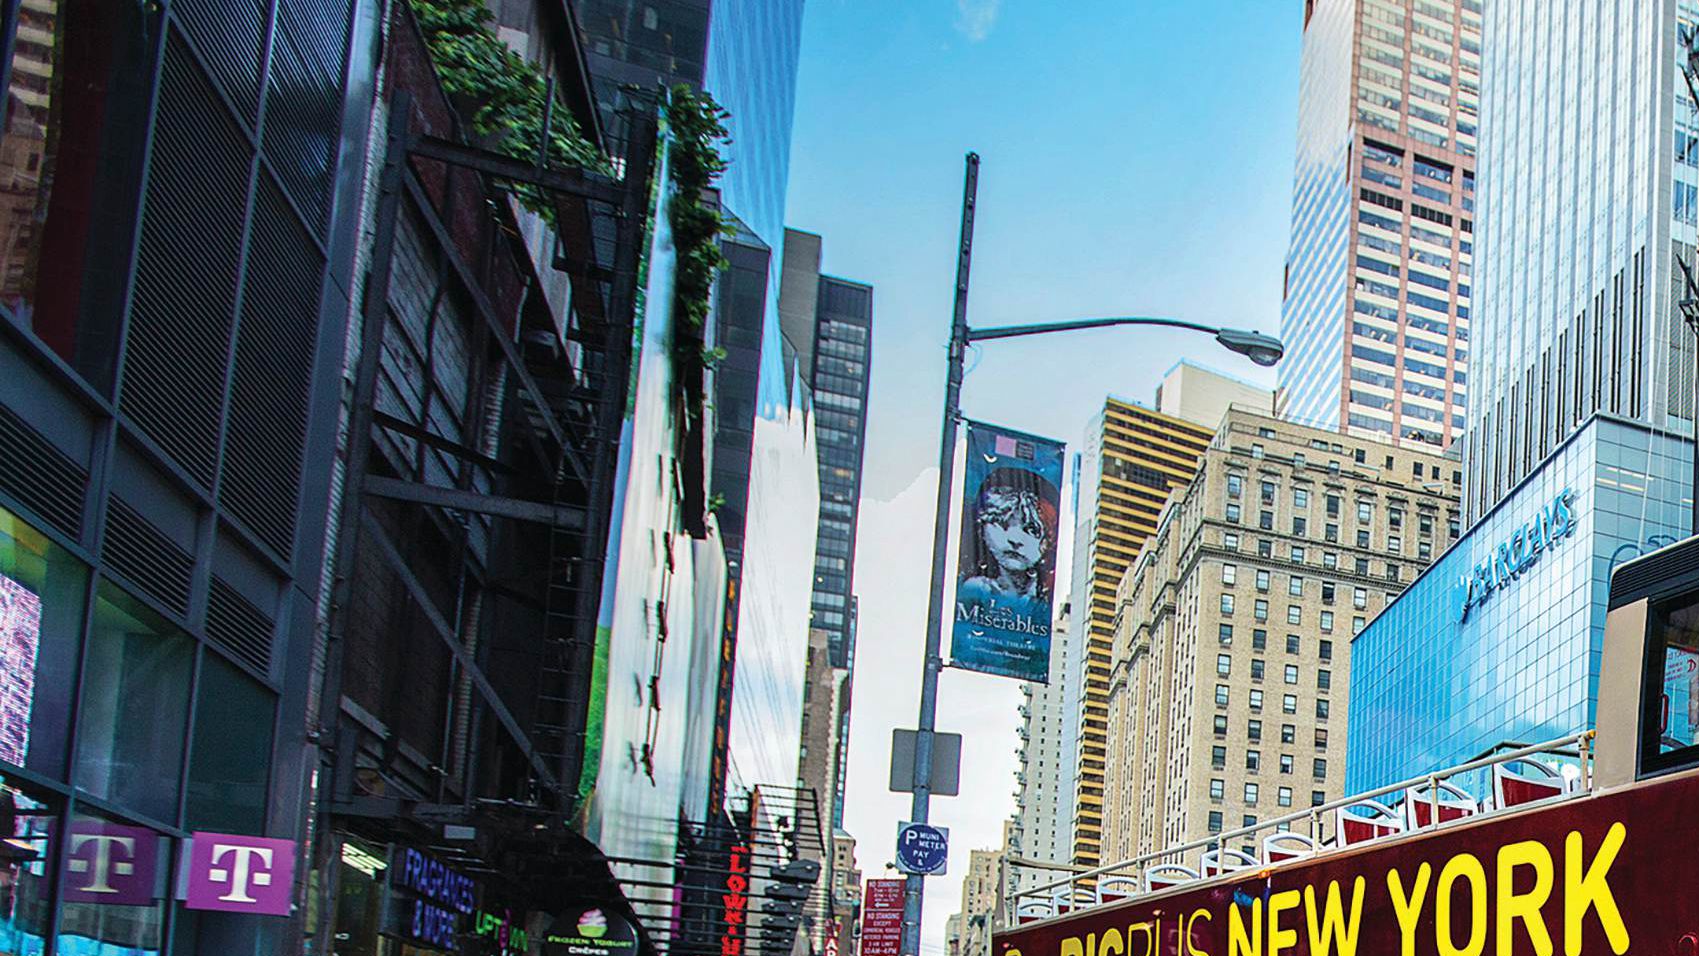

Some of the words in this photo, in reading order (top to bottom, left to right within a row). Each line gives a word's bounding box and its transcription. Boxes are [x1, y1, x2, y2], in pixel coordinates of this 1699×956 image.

[1471, 488, 1572, 602] BARCLAYS
[905, 830, 918, 845] P
[919, 832, 940, 840] MUNI
[919, 840, 946, 850] METER
[912, 849, 929, 858] PAY
[68, 835, 135, 893] T
[208, 844, 273, 903] T
[548, 935, 590, 945] FROZEN
[593, 937, 634, 948] YOGURT
